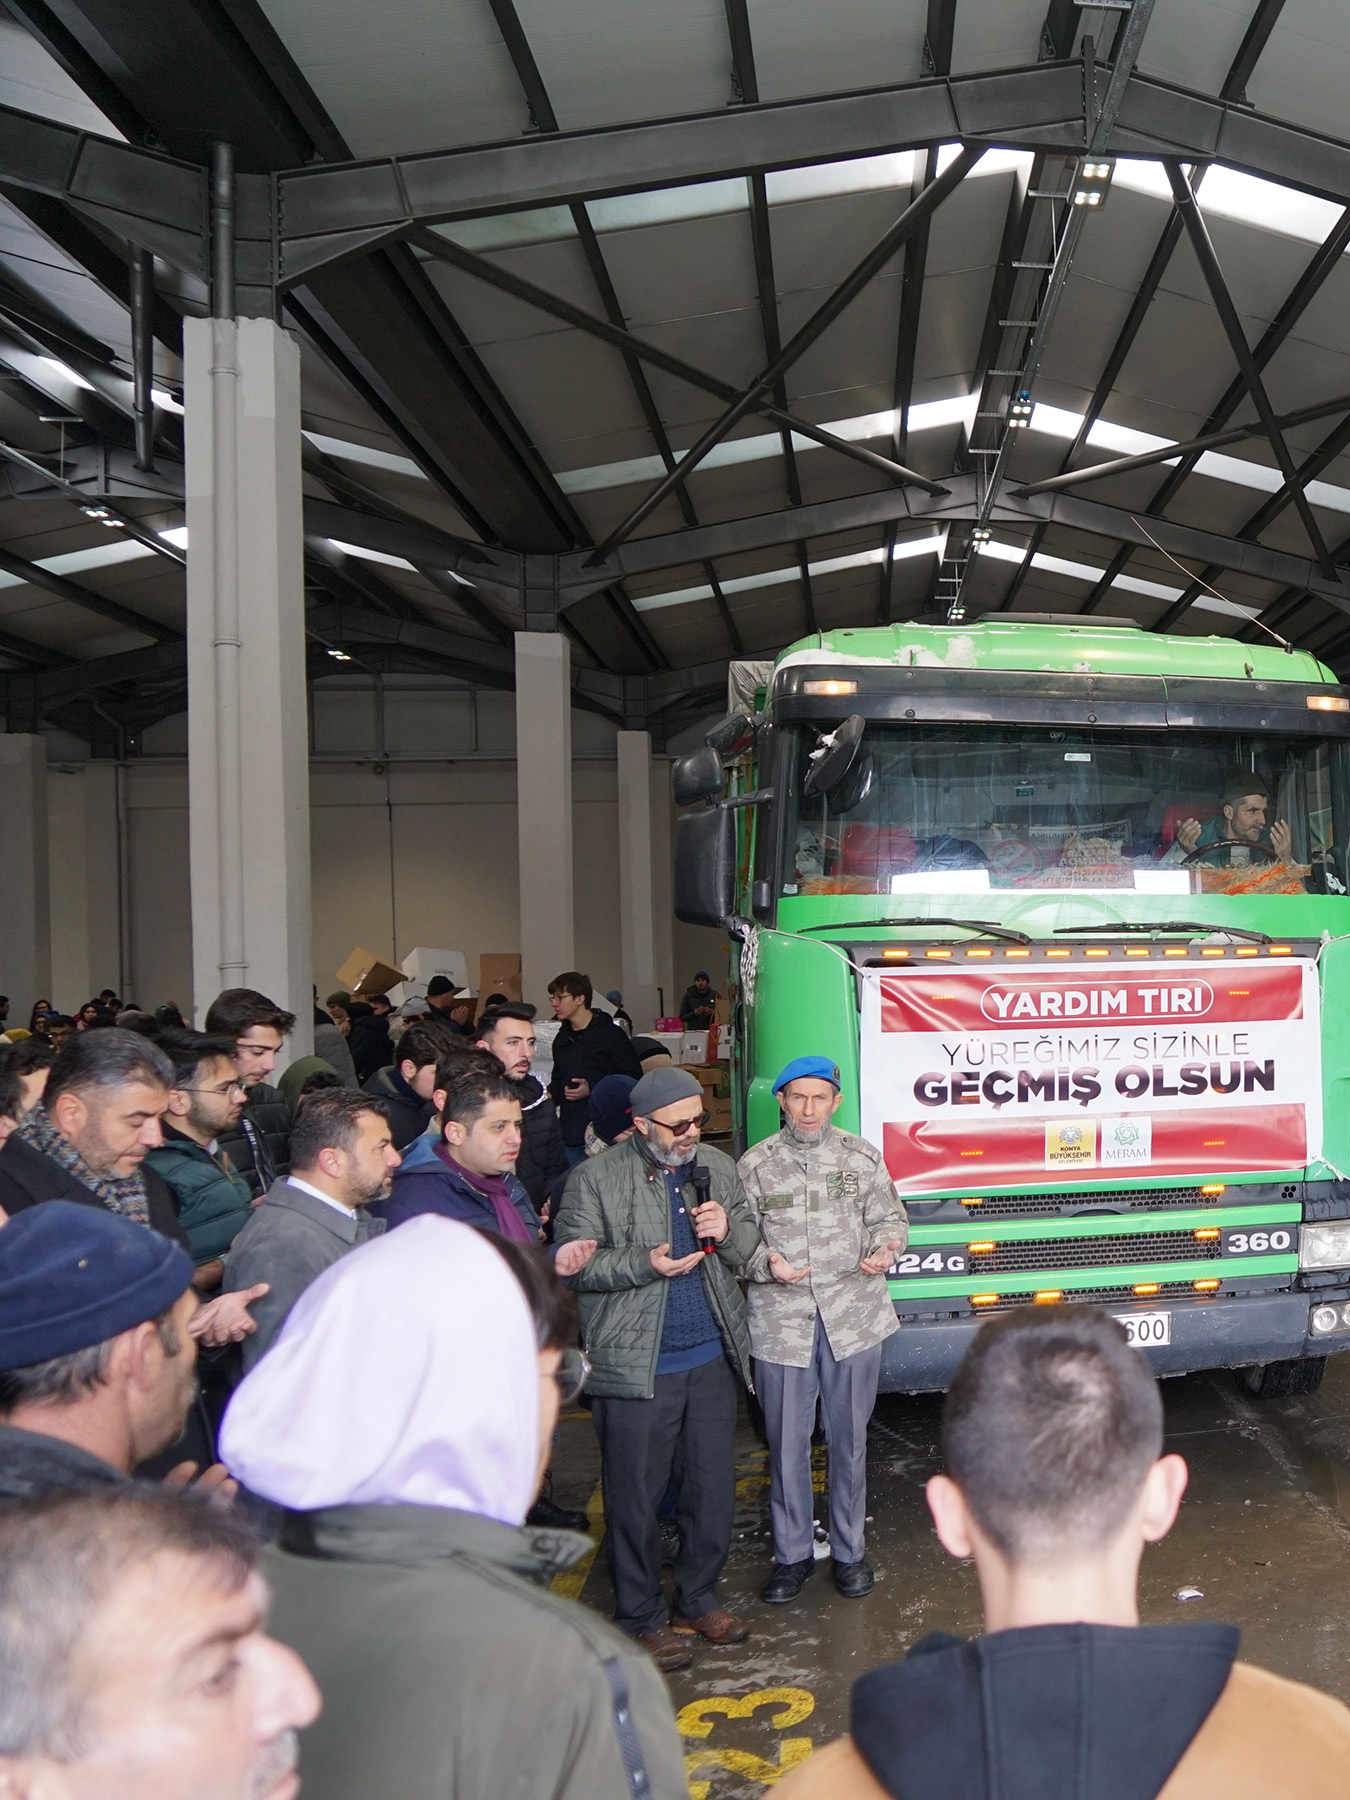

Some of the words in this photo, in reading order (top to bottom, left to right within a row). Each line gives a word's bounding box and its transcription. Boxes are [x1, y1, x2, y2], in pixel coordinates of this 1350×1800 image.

[990, 989, 1127, 1018] YARDIM
[1138, 987, 1202, 1013] TIRI
[942, 1033, 1121, 1066] YÜREĞİMİZ
[1133, 1030, 1250, 1059] SİZİNLE
[1115, 1059, 1276, 1099] OLSUN
[1105, 1148, 1147, 1159] MERAM
[1227, 1230, 1291, 1253] 360
